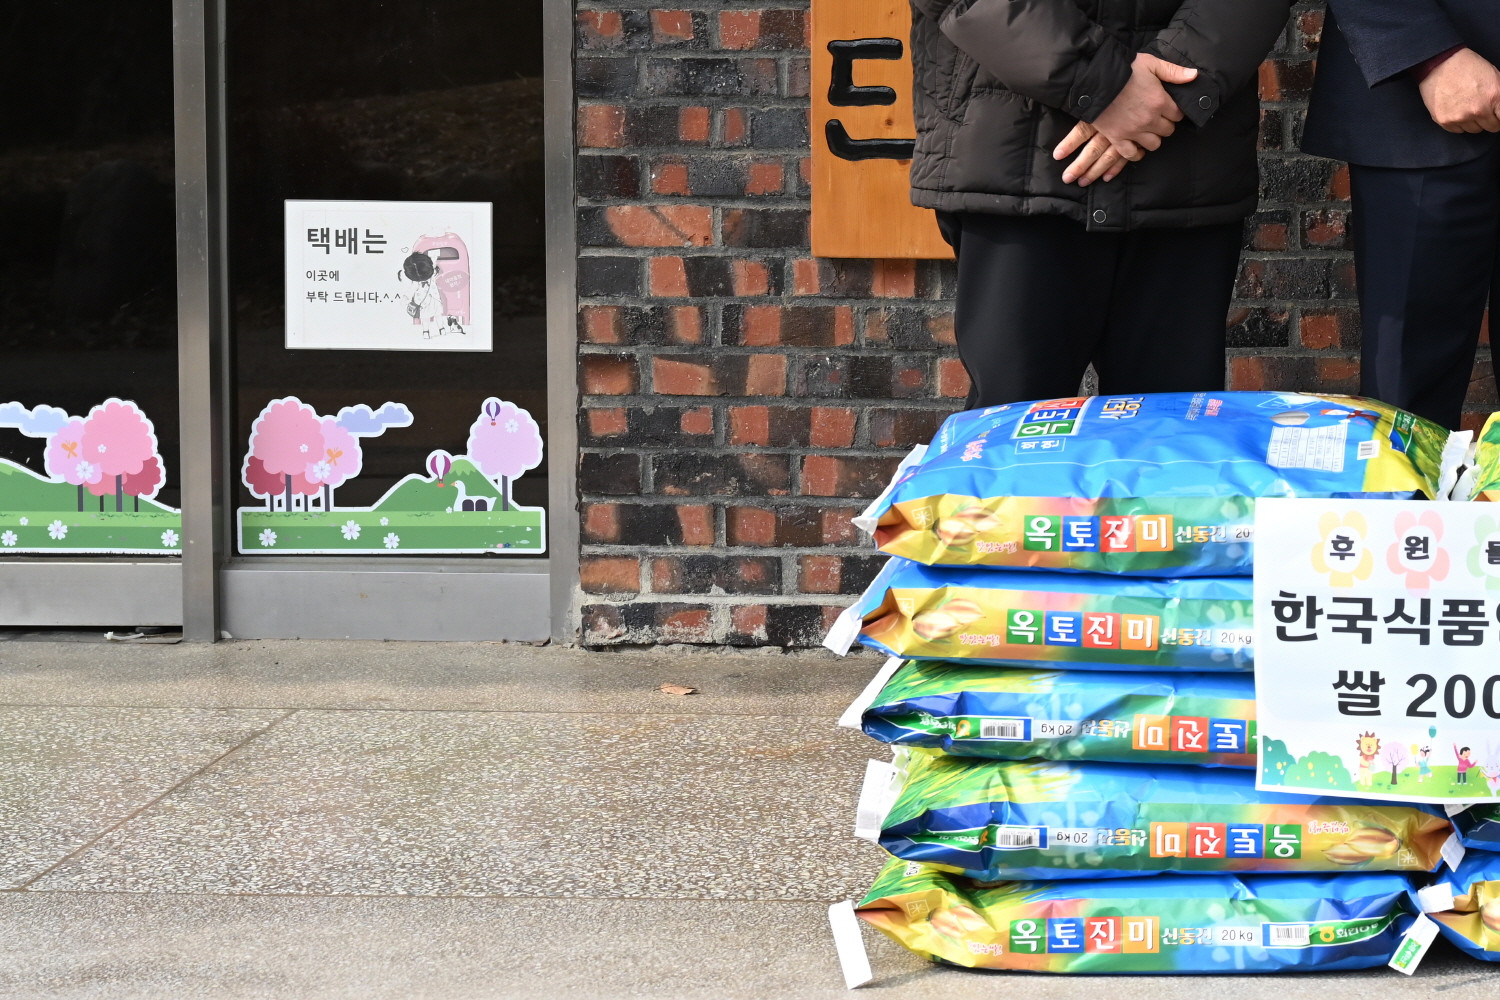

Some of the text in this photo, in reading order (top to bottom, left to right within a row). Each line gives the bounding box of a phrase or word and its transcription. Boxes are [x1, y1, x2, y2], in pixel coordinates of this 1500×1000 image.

[307, 227, 387, 255] 택배는
[305, 269, 340, 282] 이곳에
[305, 290, 329, 303] 부탁
[1023, 515, 1171, 551] 옥토진미
[1175, 525, 1228, 544] 신동진
[1010, 611, 1253, 649] 옥토진미 신동진 20 kg
[1332, 669, 1386, 716] 쌀
[1041, 722, 1056, 734] kg
[1057, 724, 1073, 735] 20
[1082, 719, 1132, 739] 신동진
[1056, 823, 1300, 858] 옥토진미 신동진 20 kg
[1010, 919, 1254, 952] 옥토진미 신동진 20 kg
